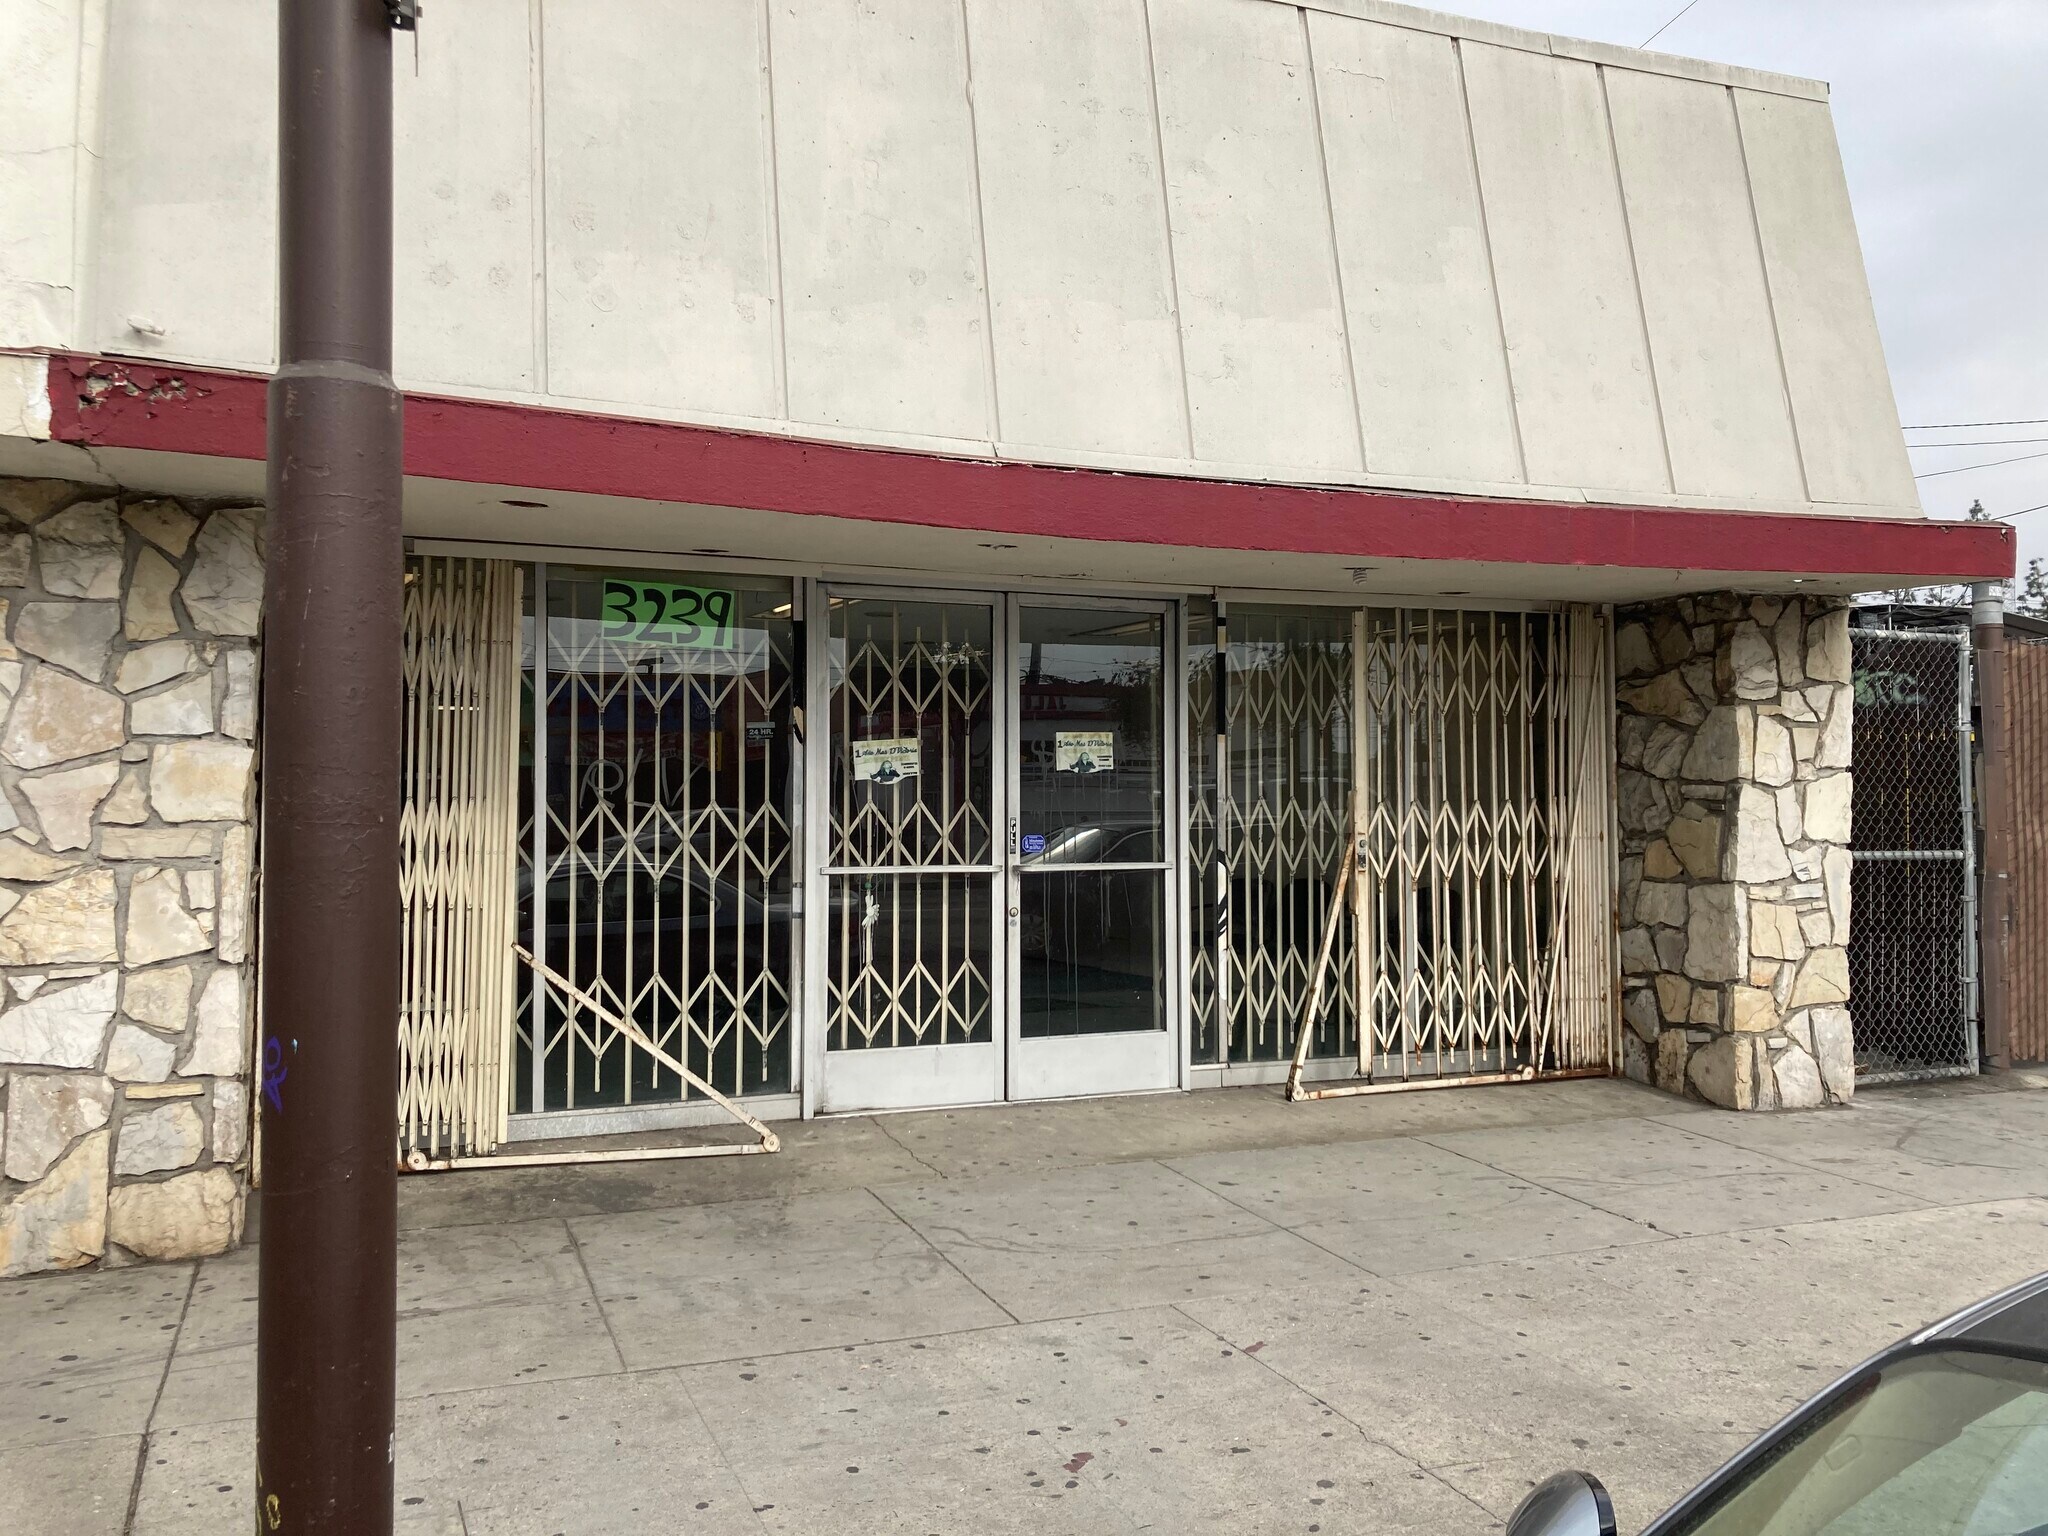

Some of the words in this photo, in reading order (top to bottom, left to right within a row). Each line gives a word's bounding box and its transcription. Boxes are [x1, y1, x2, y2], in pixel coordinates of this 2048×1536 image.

[605, 582, 732, 647] 3239
[1057, 739, 1063, 749] 1
[855, 750, 862, 758] 1
